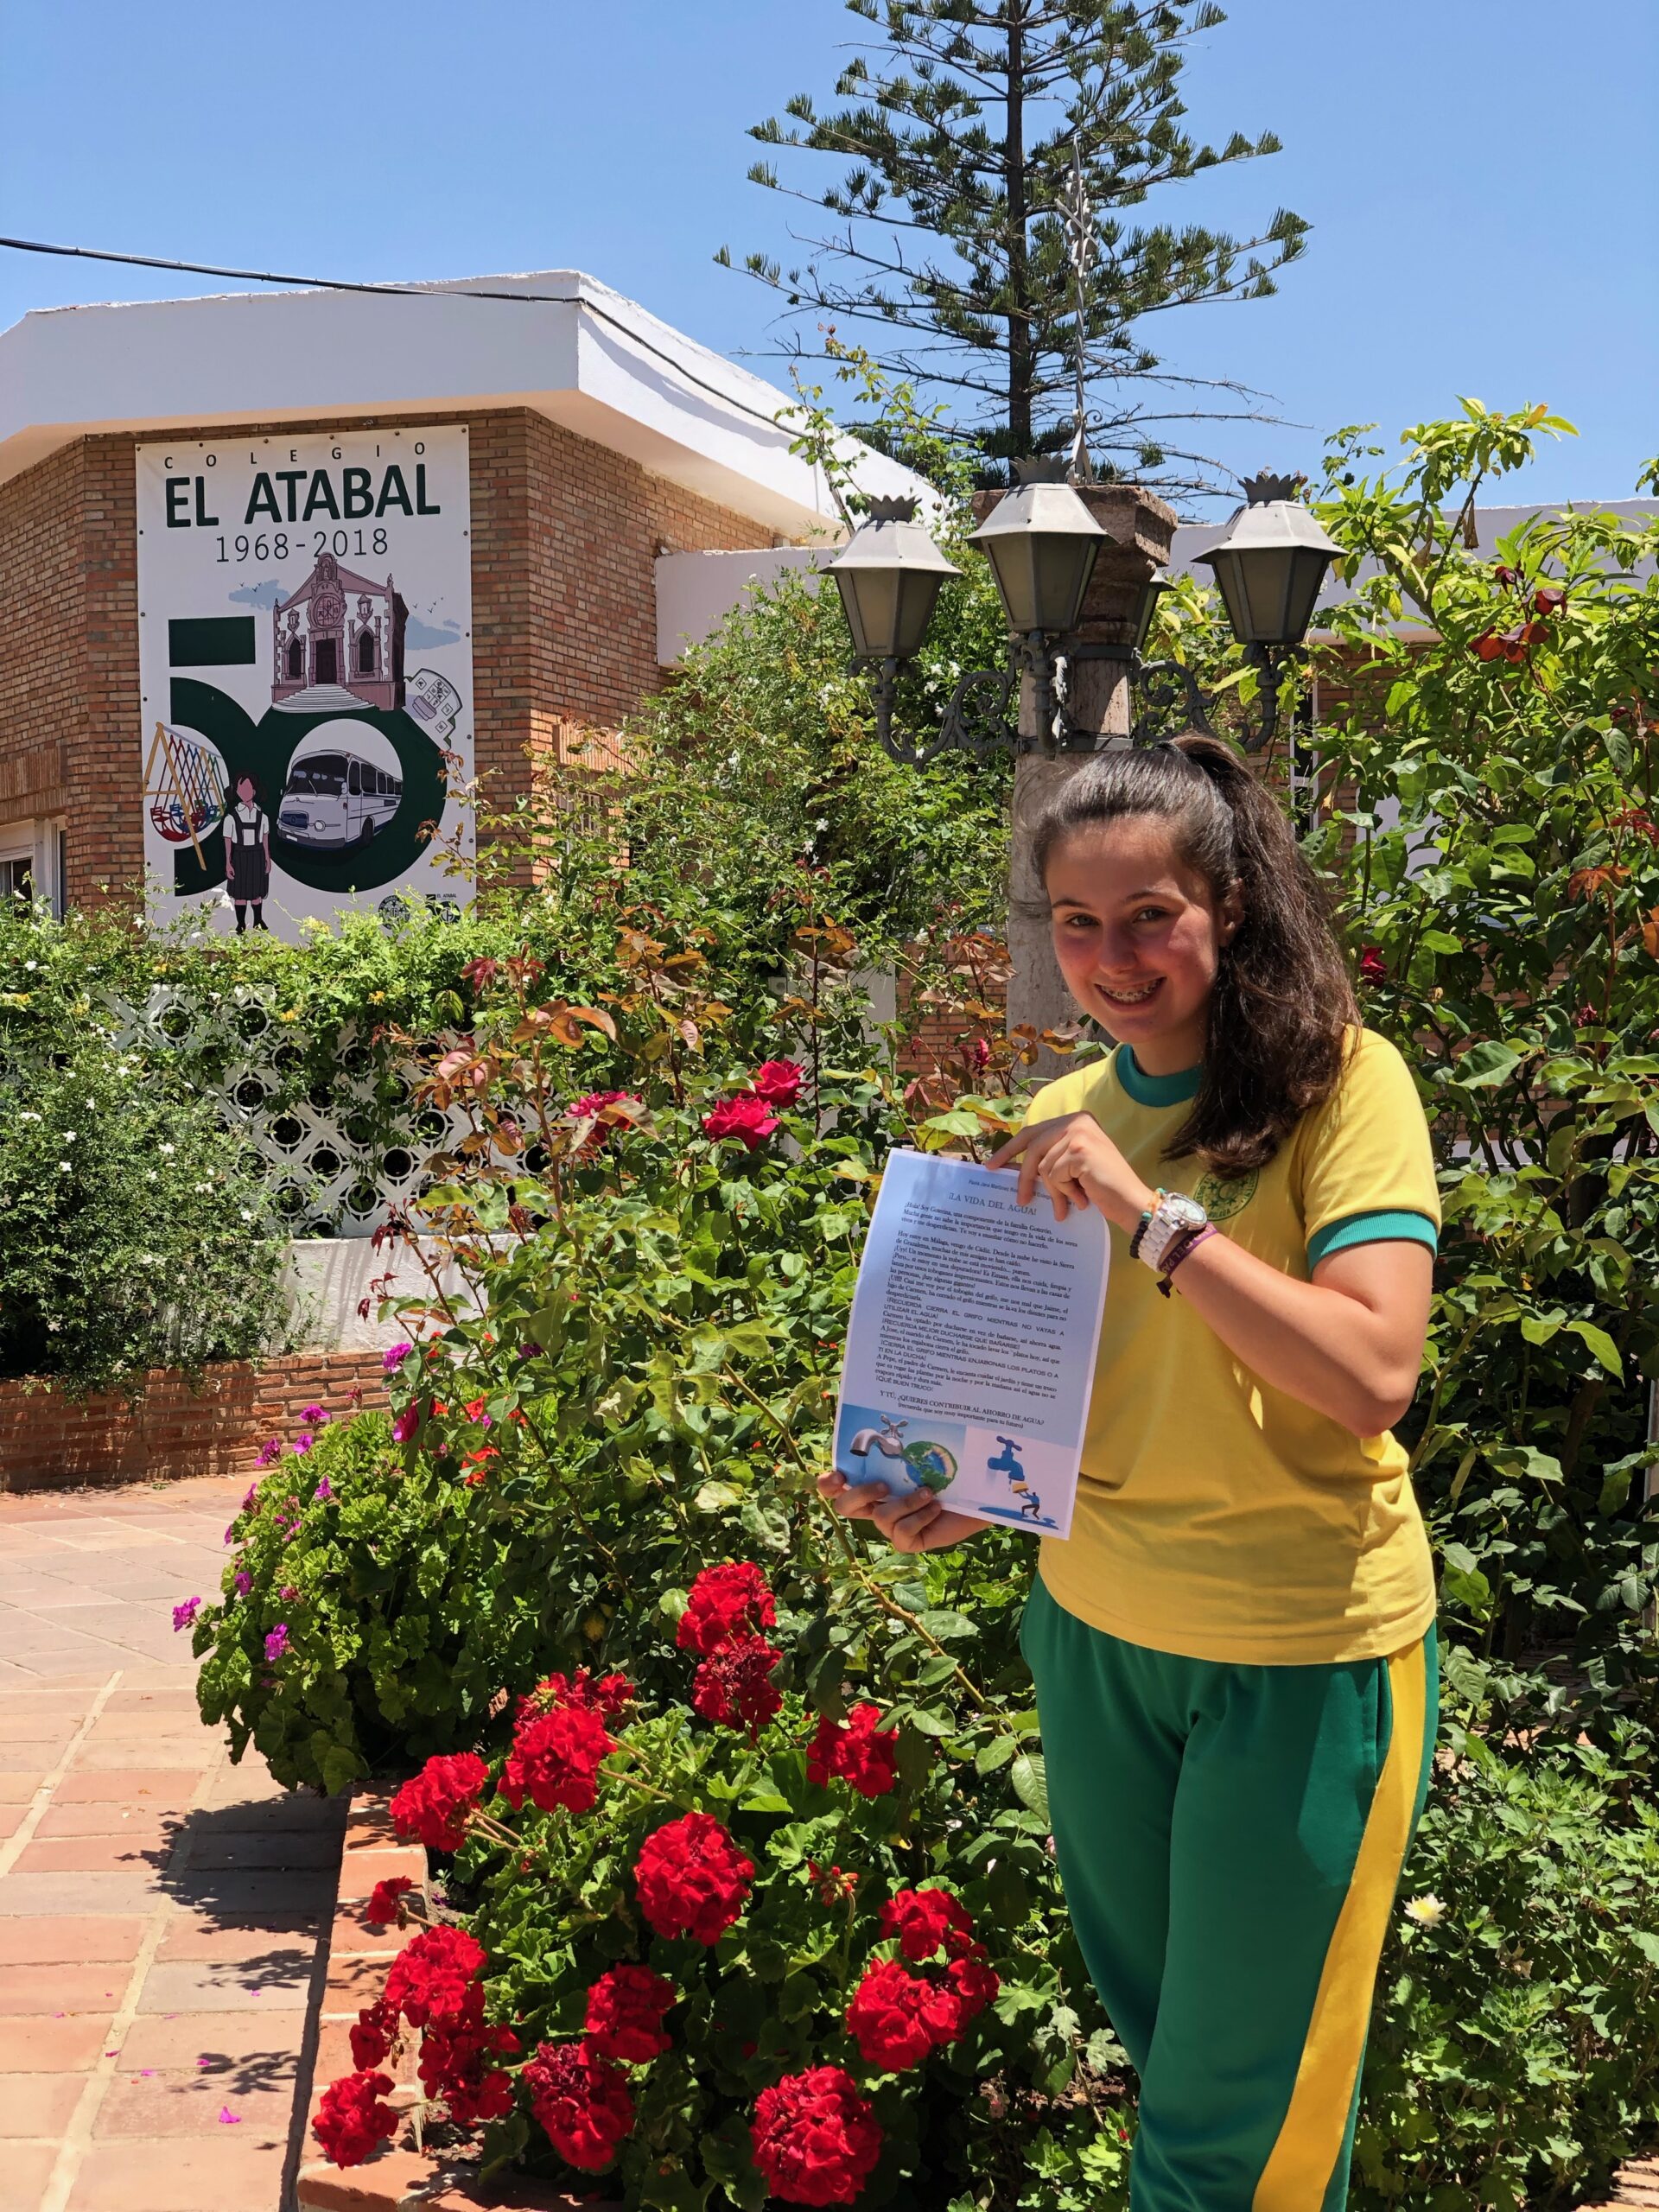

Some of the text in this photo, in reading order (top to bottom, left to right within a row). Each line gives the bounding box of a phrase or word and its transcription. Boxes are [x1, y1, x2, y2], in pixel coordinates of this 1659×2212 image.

[164, 442, 425, 469] COLEGIO
[166, 463, 441, 528] EL ATABAL
[216, 528, 388, 563] 1968-2018
[963, 1195, 986, 1206] VIDA
[987, 1199, 1005, 1210] DEL
[1007, 1204, 1036, 1216] AGUA!
[883, 1303, 910, 1313] UTILIZAR
[925, 1304, 949, 1313] CIERRA
[963, 1312, 983, 1320] GRIFO
[986, 1316, 1018, 1327] MIENTRAS
[1034, 1325, 1056, 1334] VAYAS
[918, 1325, 939, 1333] MEJOR
[939, 1329, 974, 1340] DUCHARSE
[914, 1346, 935, 1355] GRIFO
[935, 1351, 967, 1362] MIENTRAS
[967, 1357, 1006, 1369] ENJABONAS
[1020, 1366, 1046, 1376] PLATOS
[892, 1378, 910, 1387] BUEN
[928, 1399, 971, 1412] CONTRIBUIR
[981, 1408, 1011, 1419] AHORRO
